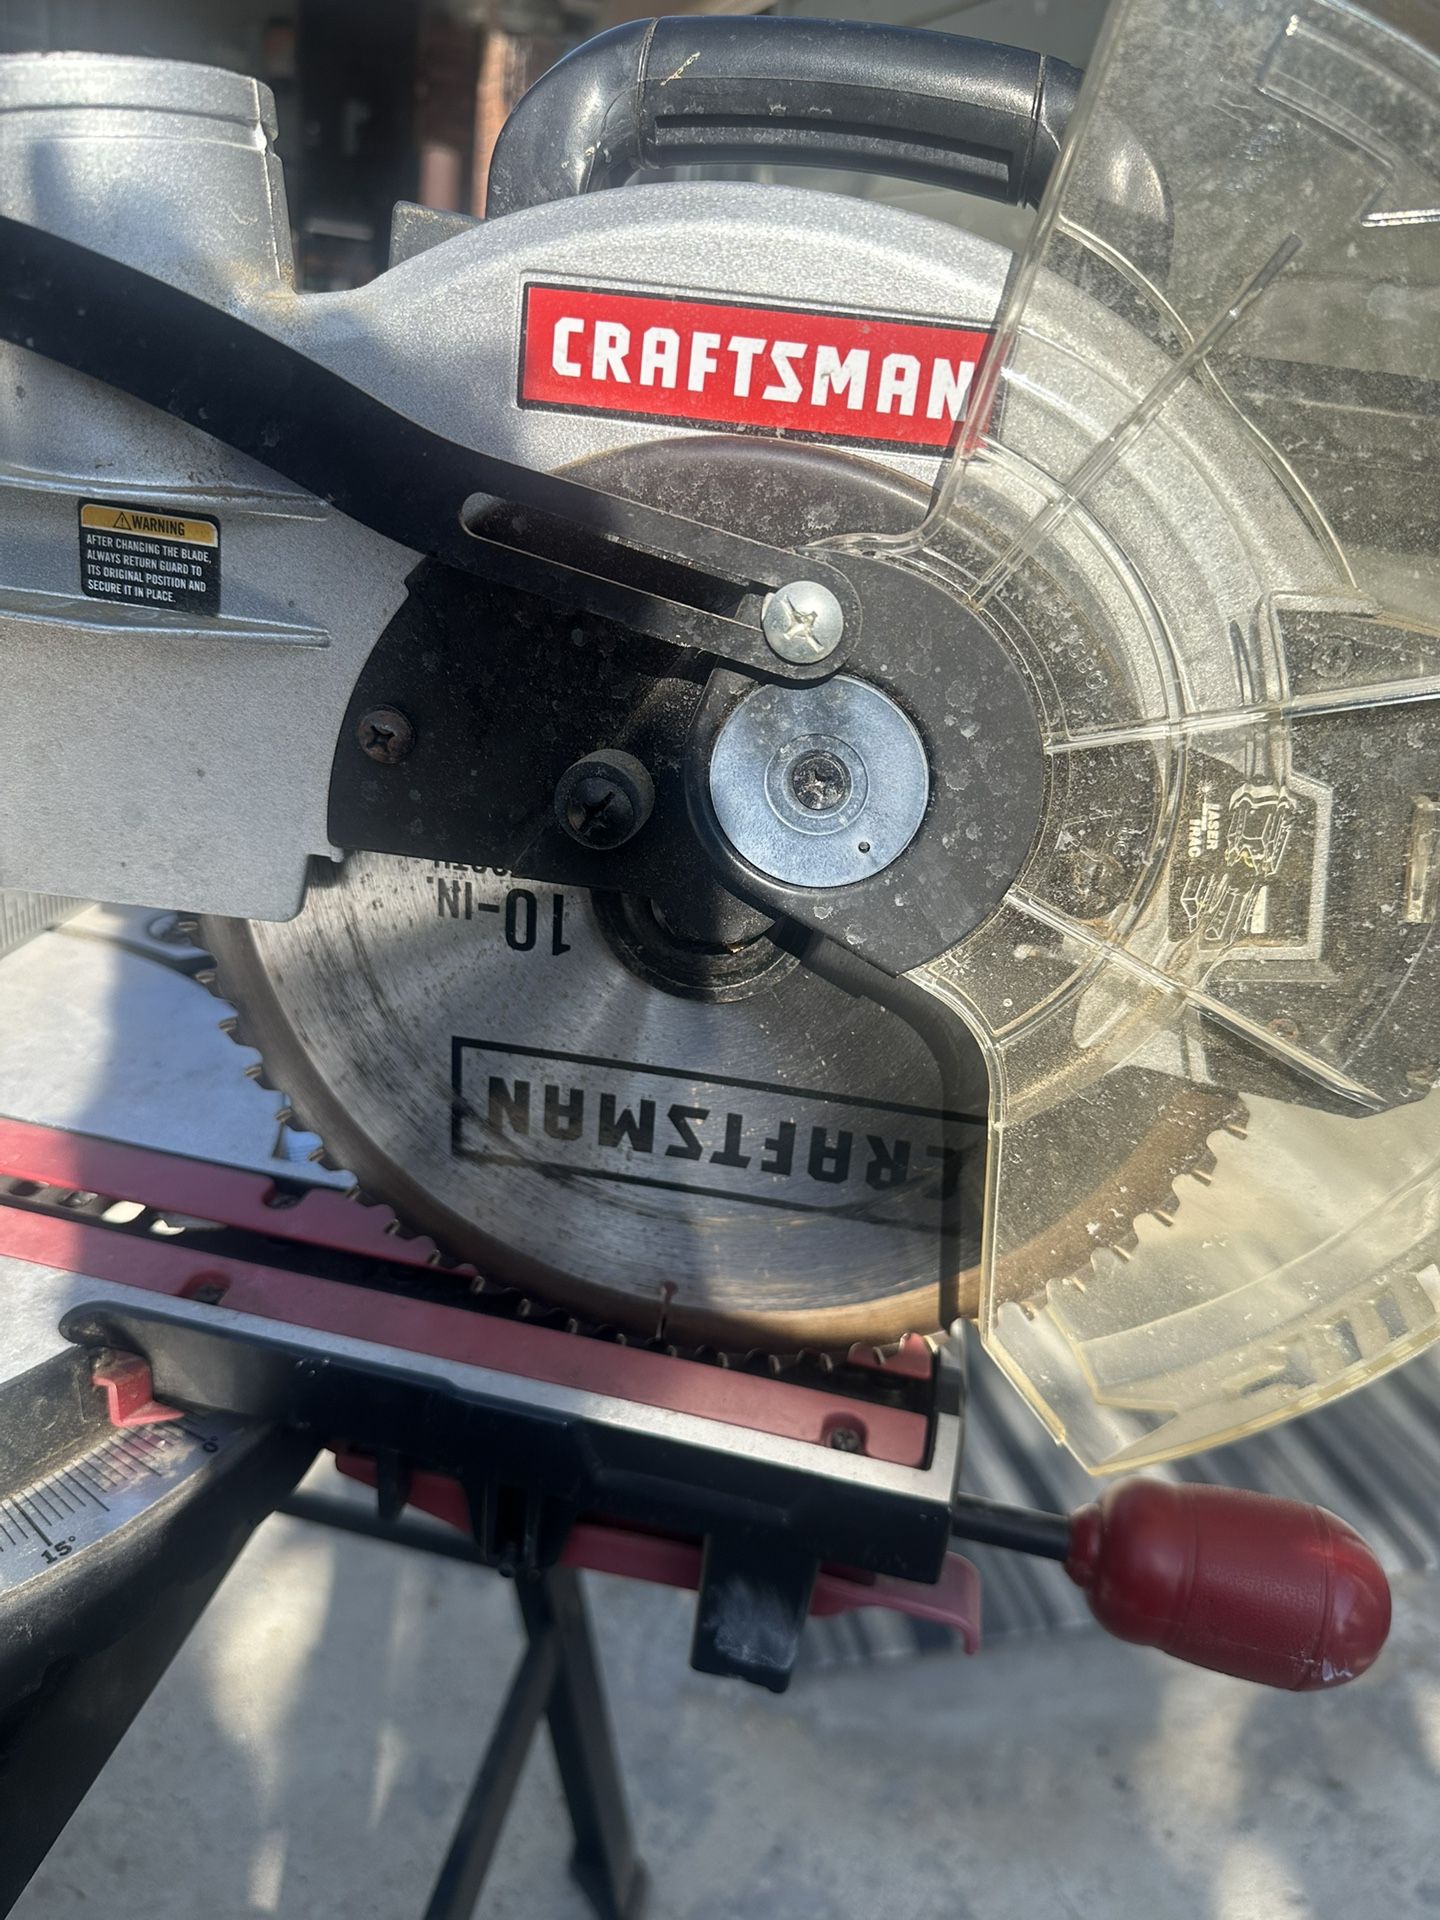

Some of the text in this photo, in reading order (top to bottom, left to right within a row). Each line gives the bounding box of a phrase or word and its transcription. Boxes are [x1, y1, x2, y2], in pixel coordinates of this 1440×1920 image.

[552, 316, 976, 422] CRAFTSMAN
[131, 514, 185, 536] WARNING
[86, 534, 212, 564] AFTER CHANGING THE BLADE,
[86, 549, 202, 577] ALWAYS RETURN GUARD TO
[87, 564, 207, 592] ITS ORIGINAL POSITION AND
[88, 579, 177, 603] SECURE IT IN PLACE.
[1188, 816, 1207, 858] TRAC
[1202, 802, 1221, 850] LASER
[426, 876, 571, 957] 10-IN.
[40, 1535, 77, 1565] 15°
